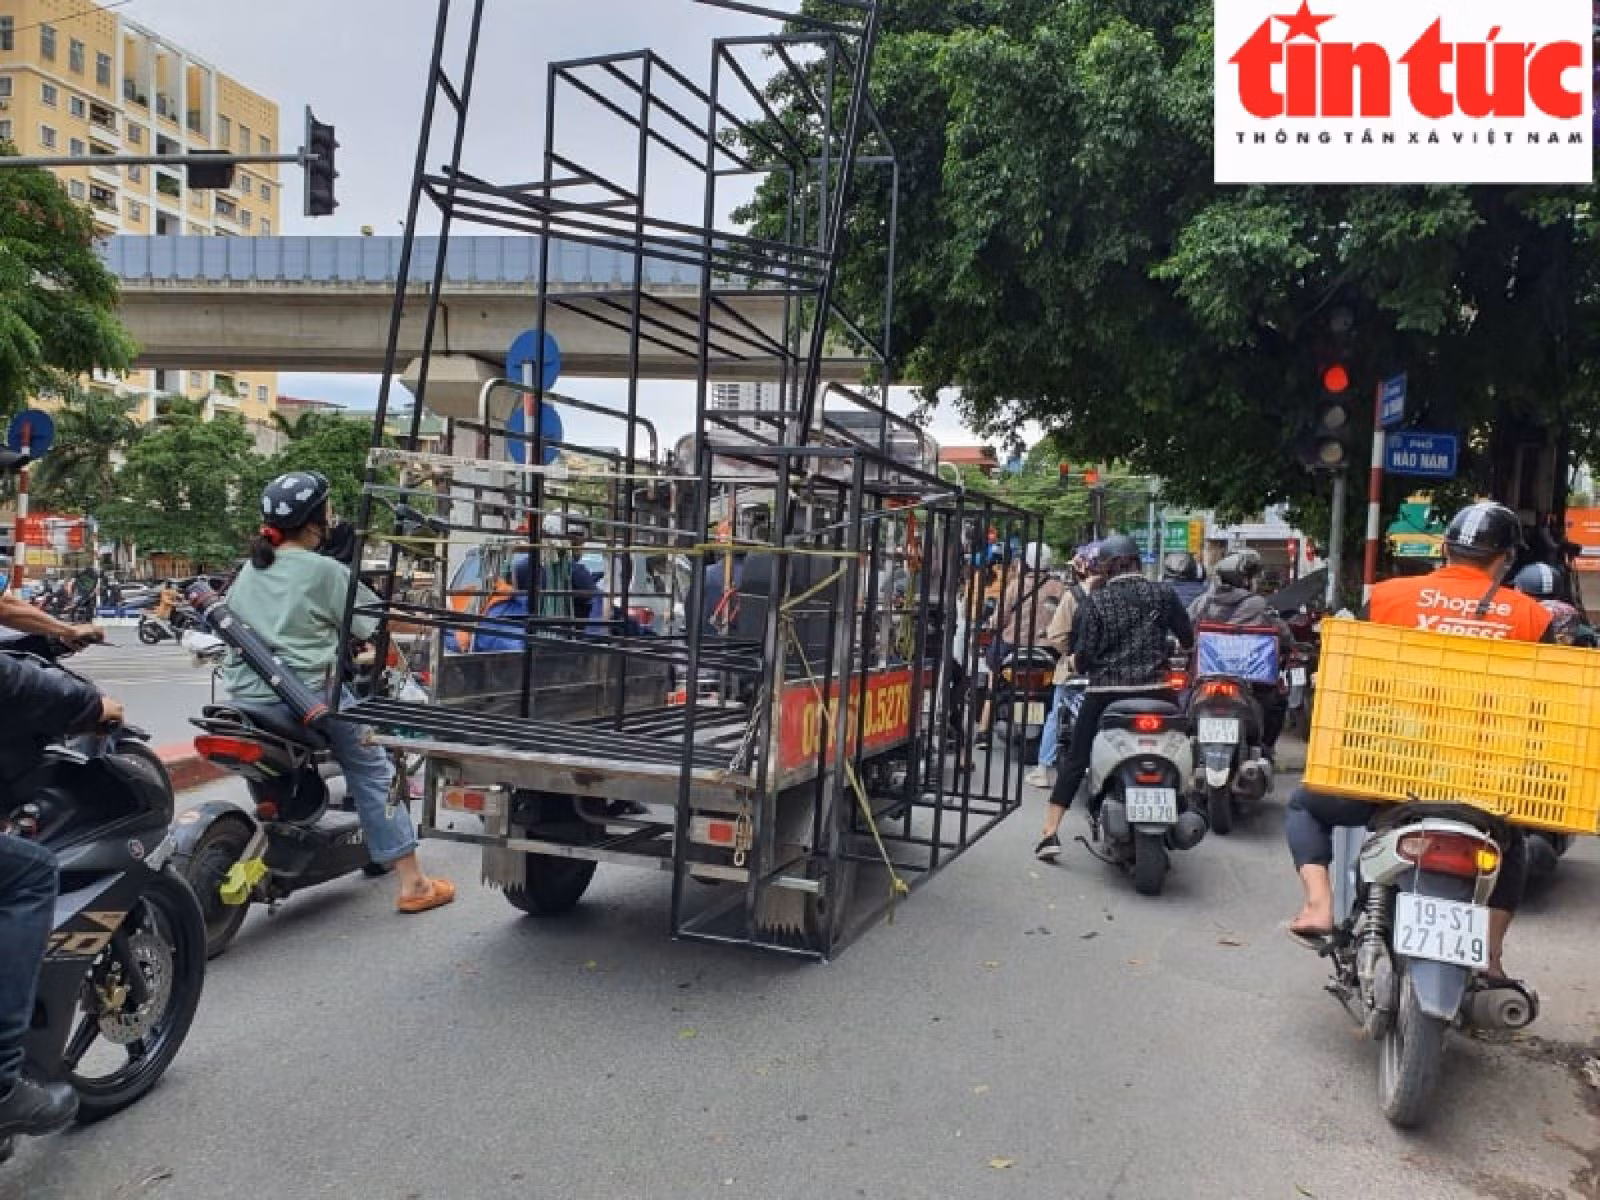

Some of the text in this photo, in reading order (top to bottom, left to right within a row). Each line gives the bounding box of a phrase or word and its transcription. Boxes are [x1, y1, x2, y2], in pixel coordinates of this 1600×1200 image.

[1420, 453, 1449, 469] NAM
[1414, 899, 1474, 933] 19-S1
[1400, 924, 1483, 963] 271.49
